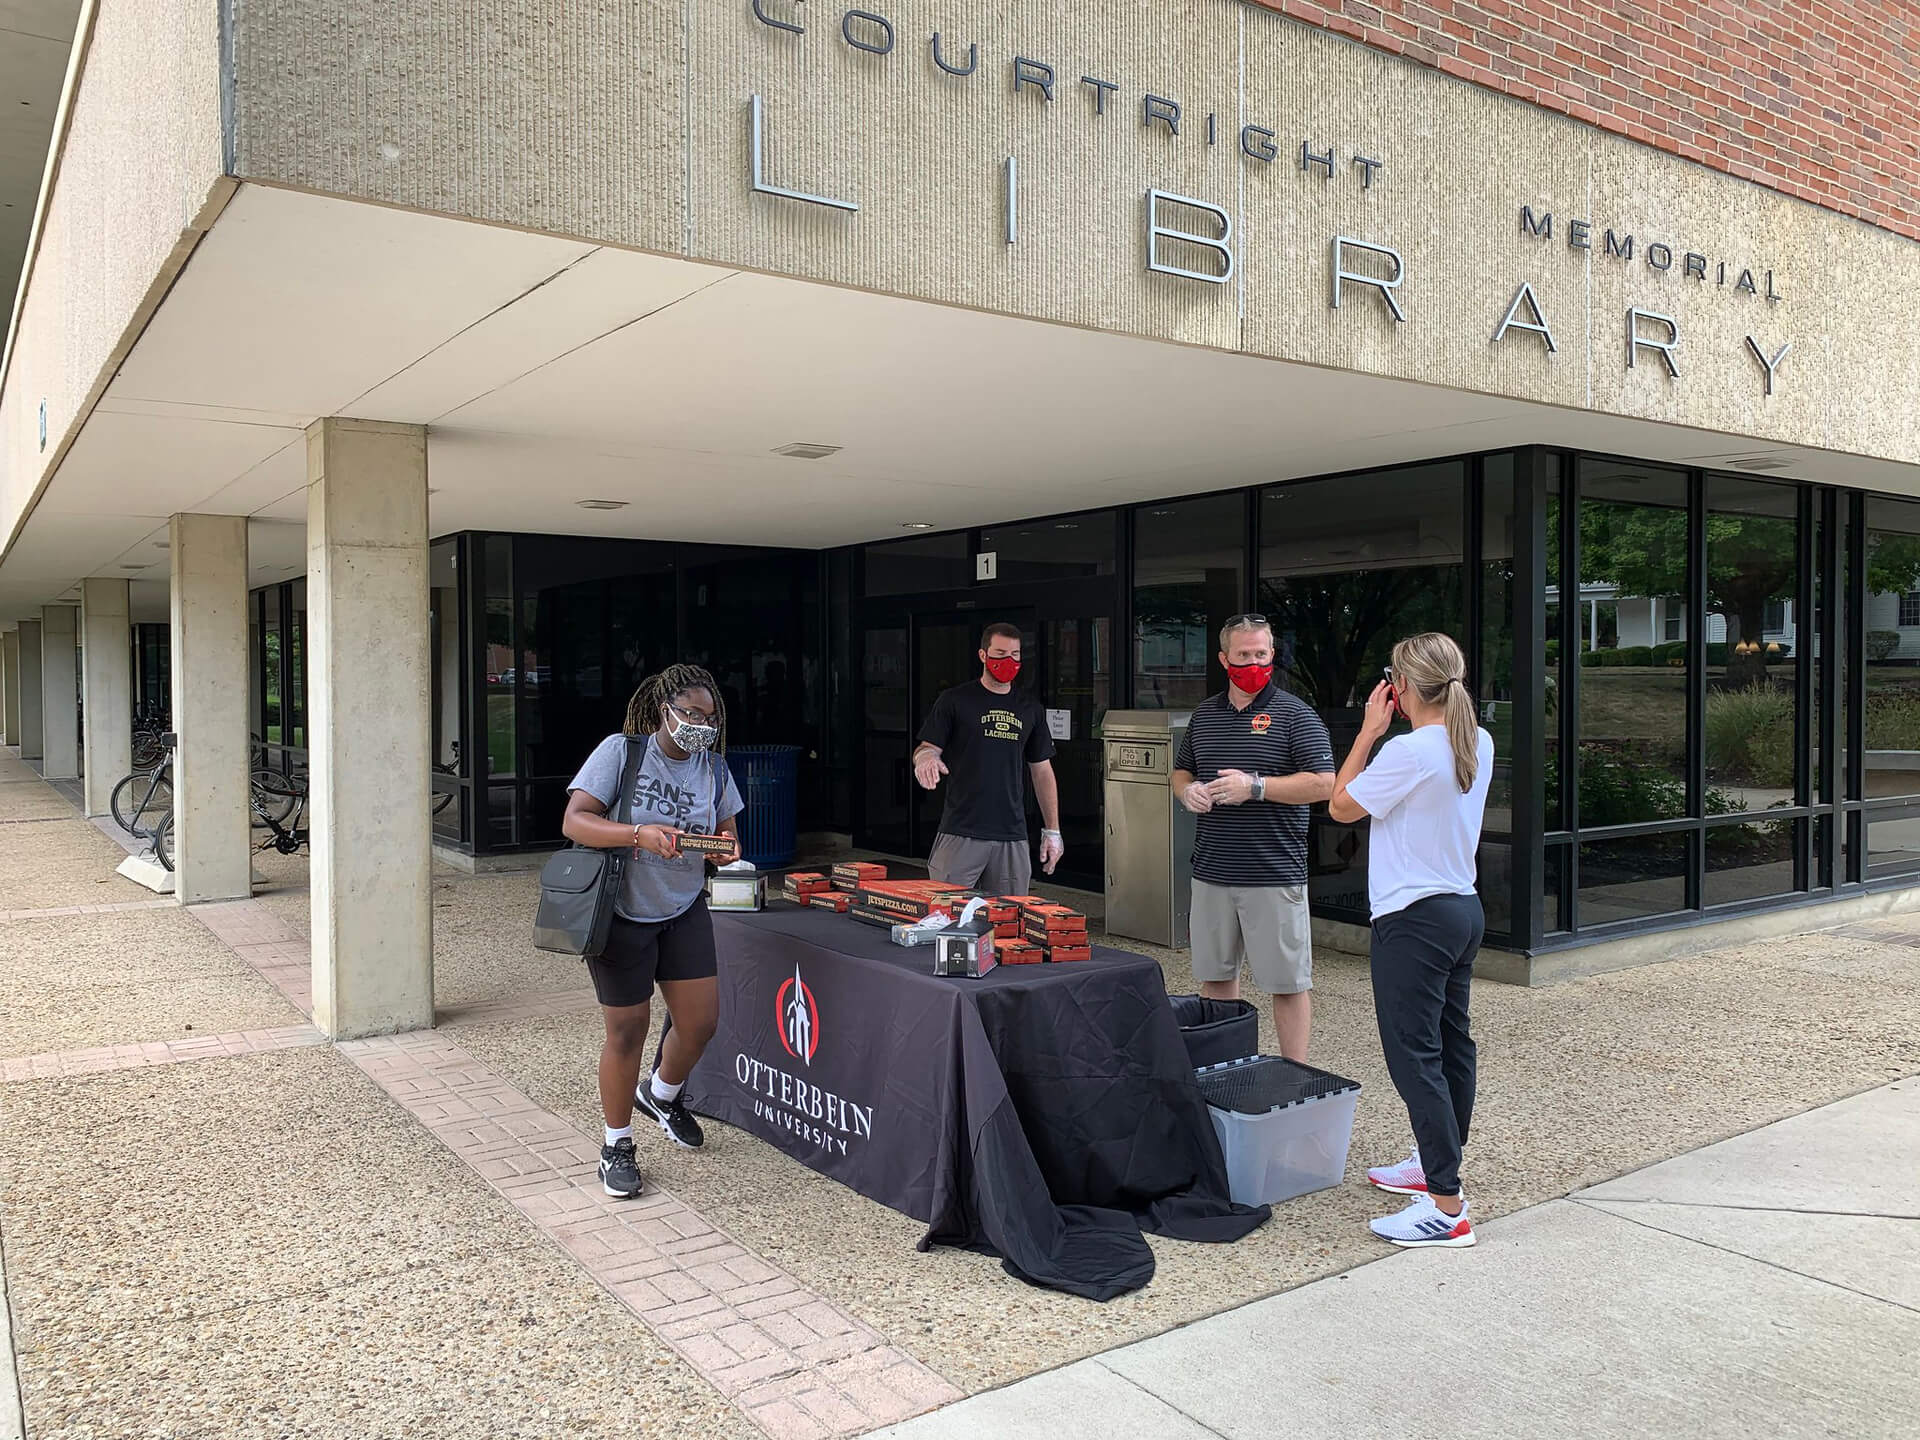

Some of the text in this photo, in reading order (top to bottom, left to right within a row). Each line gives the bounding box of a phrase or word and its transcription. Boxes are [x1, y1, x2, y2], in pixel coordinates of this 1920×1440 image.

[752, 0, 1382, 188] COURTRIGHT
[749, 94, 1793, 395] LIBRARY
[1522, 205, 1782, 302] MEMORIAL
[983, 557, 989, 575] 1
[981, 714, 1023, 730] OTTERBEIN
[984, 729, 1020, 741] LACROSSE
[867, 894, 918, 914] JETSPIZZA.COM
[735, 1053, 874, 1141] OTTERBEIN
[754, 1099, 847, 1156] UNIVERSITY
